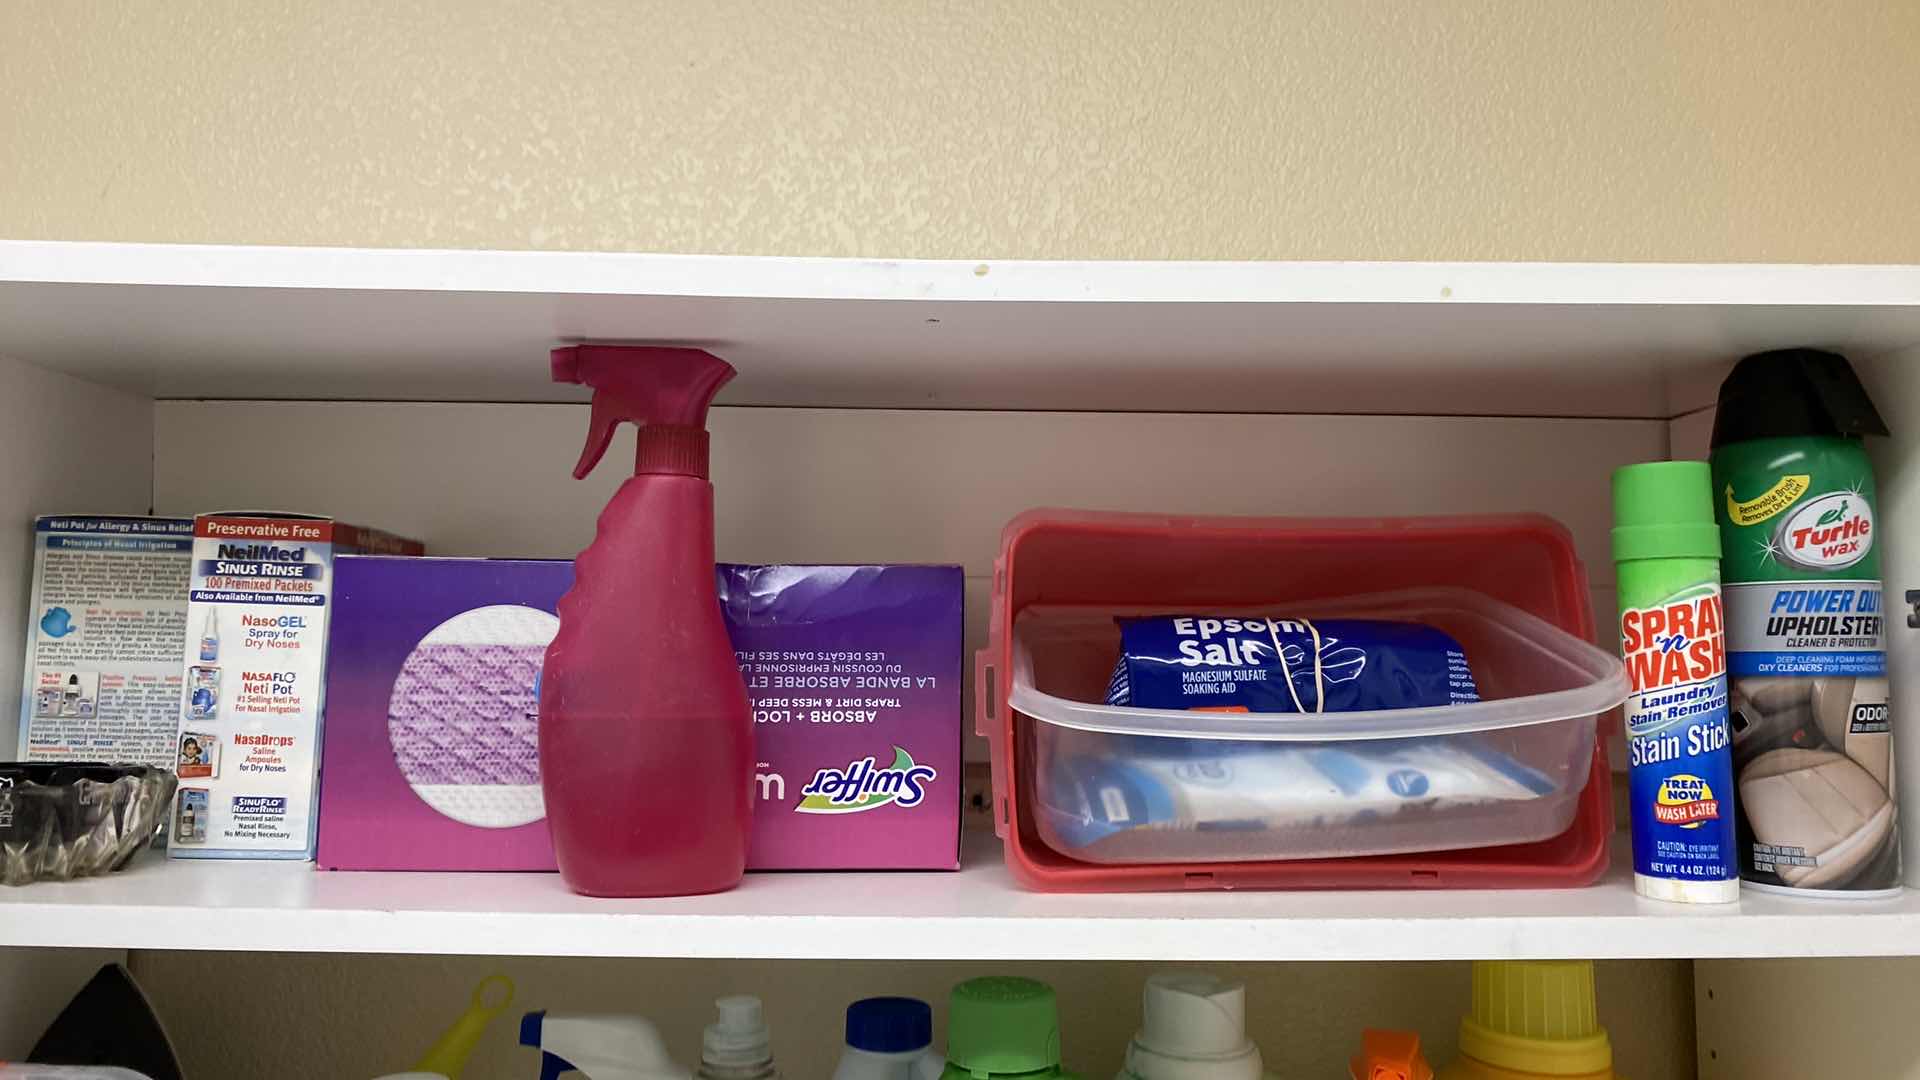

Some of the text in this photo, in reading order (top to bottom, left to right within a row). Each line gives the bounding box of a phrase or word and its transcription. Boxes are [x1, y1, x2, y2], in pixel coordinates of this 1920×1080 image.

[1739, 495, 1777, 512] Removable
[1742, 509, 1774, 521] Removes
[1772, 499, 1787, 510] Dirt
[50, 520, 68, 530] Neti
[71, 520, 84, 530] Pot
[100, 522, 130, 532] Allergy
[133, 523, 139, 531] &
[142, 523, 166, 532] Sinus
[207, 522, 320, 538] Preservative Free
[1792, 515, 1870, 550] Turtle
[218, 544, 305, 561] NeilMed
[1822, 541, 1858, 558] wax
[206, 578, 312, 592] 100 Premixed Packets
[196, 592, 214, 600] Also
[216, 592, 253, 602] Available
[1770, 590, 1856, 614] POWER
[242, 615, 306, 628] NasoGEL
[249, 629, 298, 640] Spray for
[1173, 618, 1305, 640] Epsom
[245, 638, 300, 649] Dry Noses
[1786, 638, 1826, 648] CLEANER
[735, 652, 884, 664] LES DÉGÂTS DANS SES FIL
[1178, 638, 1260, 666] Salt
[1625, 635, 1726, 692] WASH
[1776, 656, 1796, 664] DEEP
[1797, 656, 1834, 664] CLEANING
[1836, 656, 1854, 664] FOAM
[756, 664, 830, 672] EMPRISONNE
[834, 664, 882, 673] COUSSIN
[886, 664, 902, 673] DU
[1758, 664, 1776, 672] OXY
[1778, 664, 1822, 672] CLEANERS
[1824, 664, 1838, 672] FOR
[749, 676, 936, 688] LA BANDE ABSORBE ET
[1182, 670, 1266, 682] MAGNESIUM SULFATE
[244, 684, 292, 694] Neti Pot
[1182, 682, 1236, 694] SOAKING AID
[248, 696, 272, 704] Selling
[273, 696, 288, 704] Neti
[750, 698, 902, 707] TRAPS DIRT & MESS DEEP I
[1642, 686, 1714, 709] Laundry
[235, 704, 300, 714] For Nasal Irrigation
[1630, 696, 1726, 727] Stain Remover
[796, 712, 804, 720] +
[810, 711, 876, 722] ABSORB
[234, 734, 294, 747] NasaDrops
[1632, 717, 1730, 767] Stain Stick
[246, 756, 282, 764] Ampoules
[250, 764, 262, 773] Dry
[803, 759, 936, 803] Swiffer
[1664, 780, 1705, 789] TREAT
[1668, 790, 1702, 800] NOW
[1656, 803, 1718, 820] WASH LATER
[1651, 862, 1664, 872] NET
[1665, 864, 1678, 873] WT.
[1680, 864, 1692, 874] 4.4
[1693, 866, 1706, 875] OZ.
